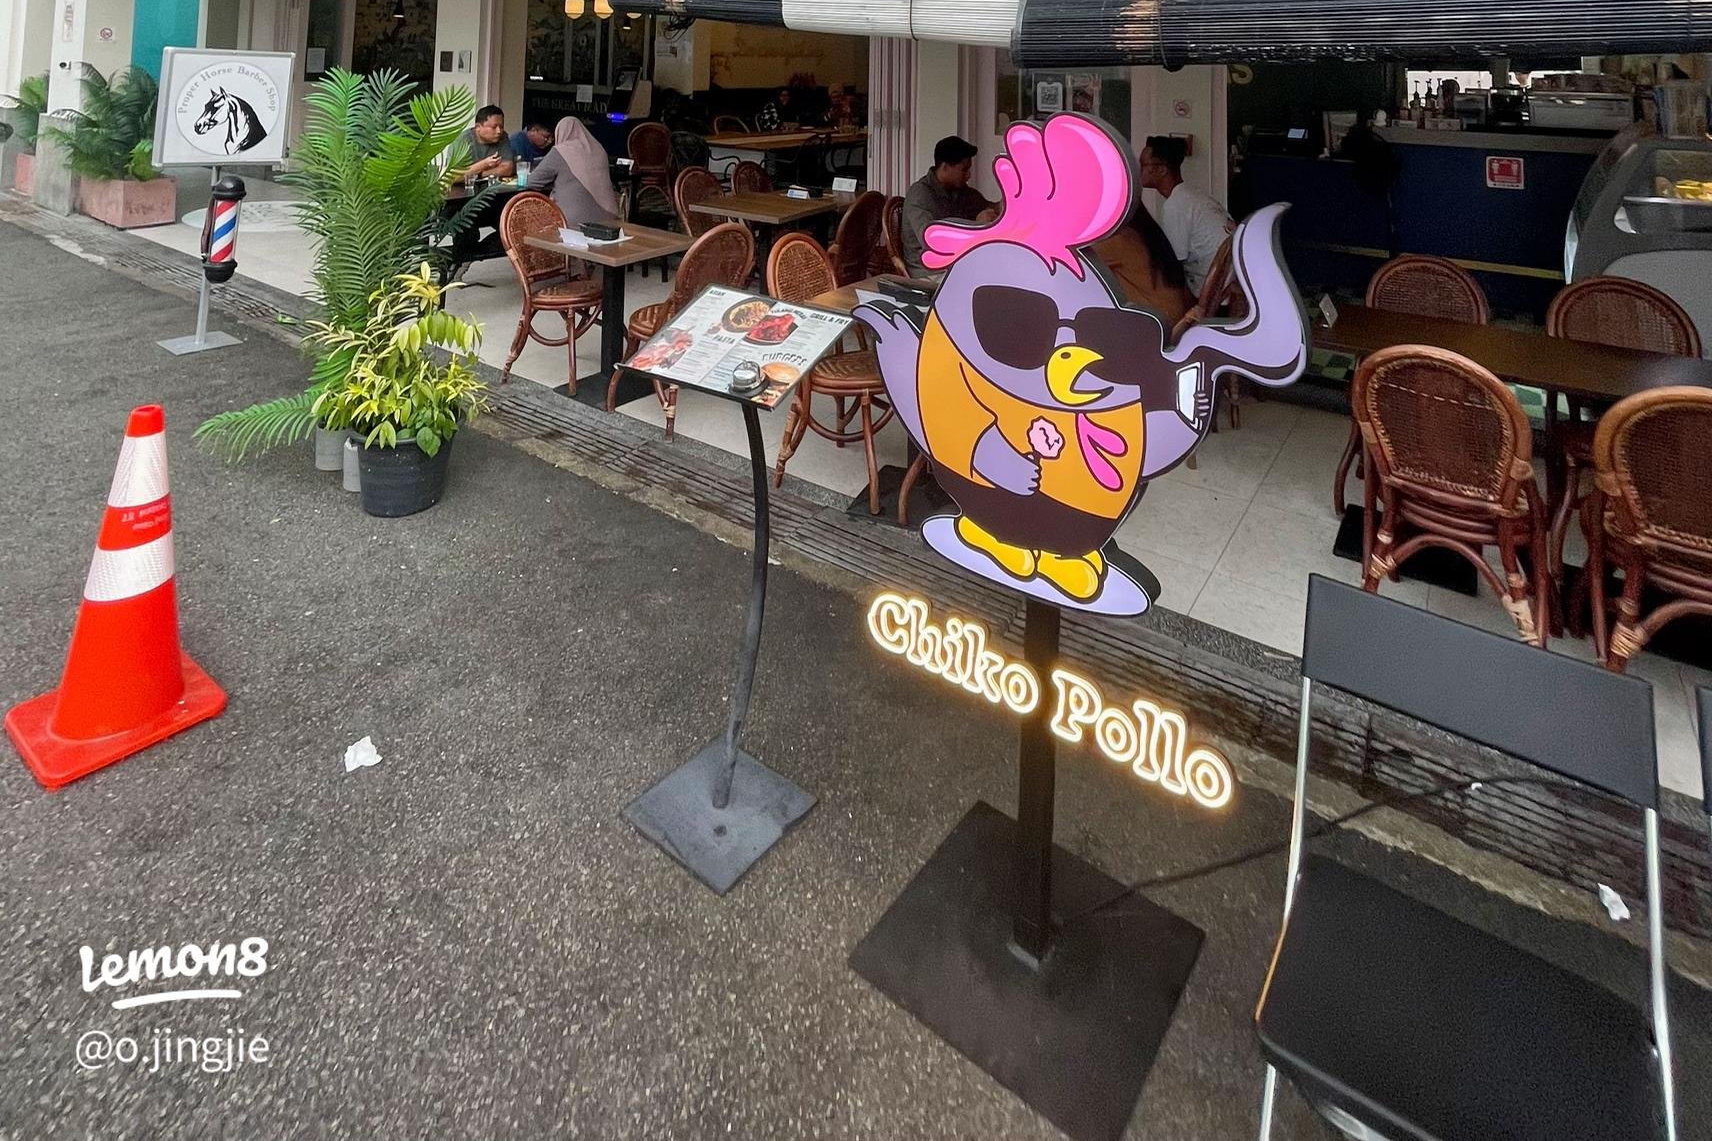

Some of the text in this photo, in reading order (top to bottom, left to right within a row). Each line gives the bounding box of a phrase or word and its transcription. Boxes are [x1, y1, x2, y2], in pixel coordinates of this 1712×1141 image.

[178, 65, 277, 114] Proper Horse Barber Shop
[867, 593, 1234, 809] Chiko Pollo
